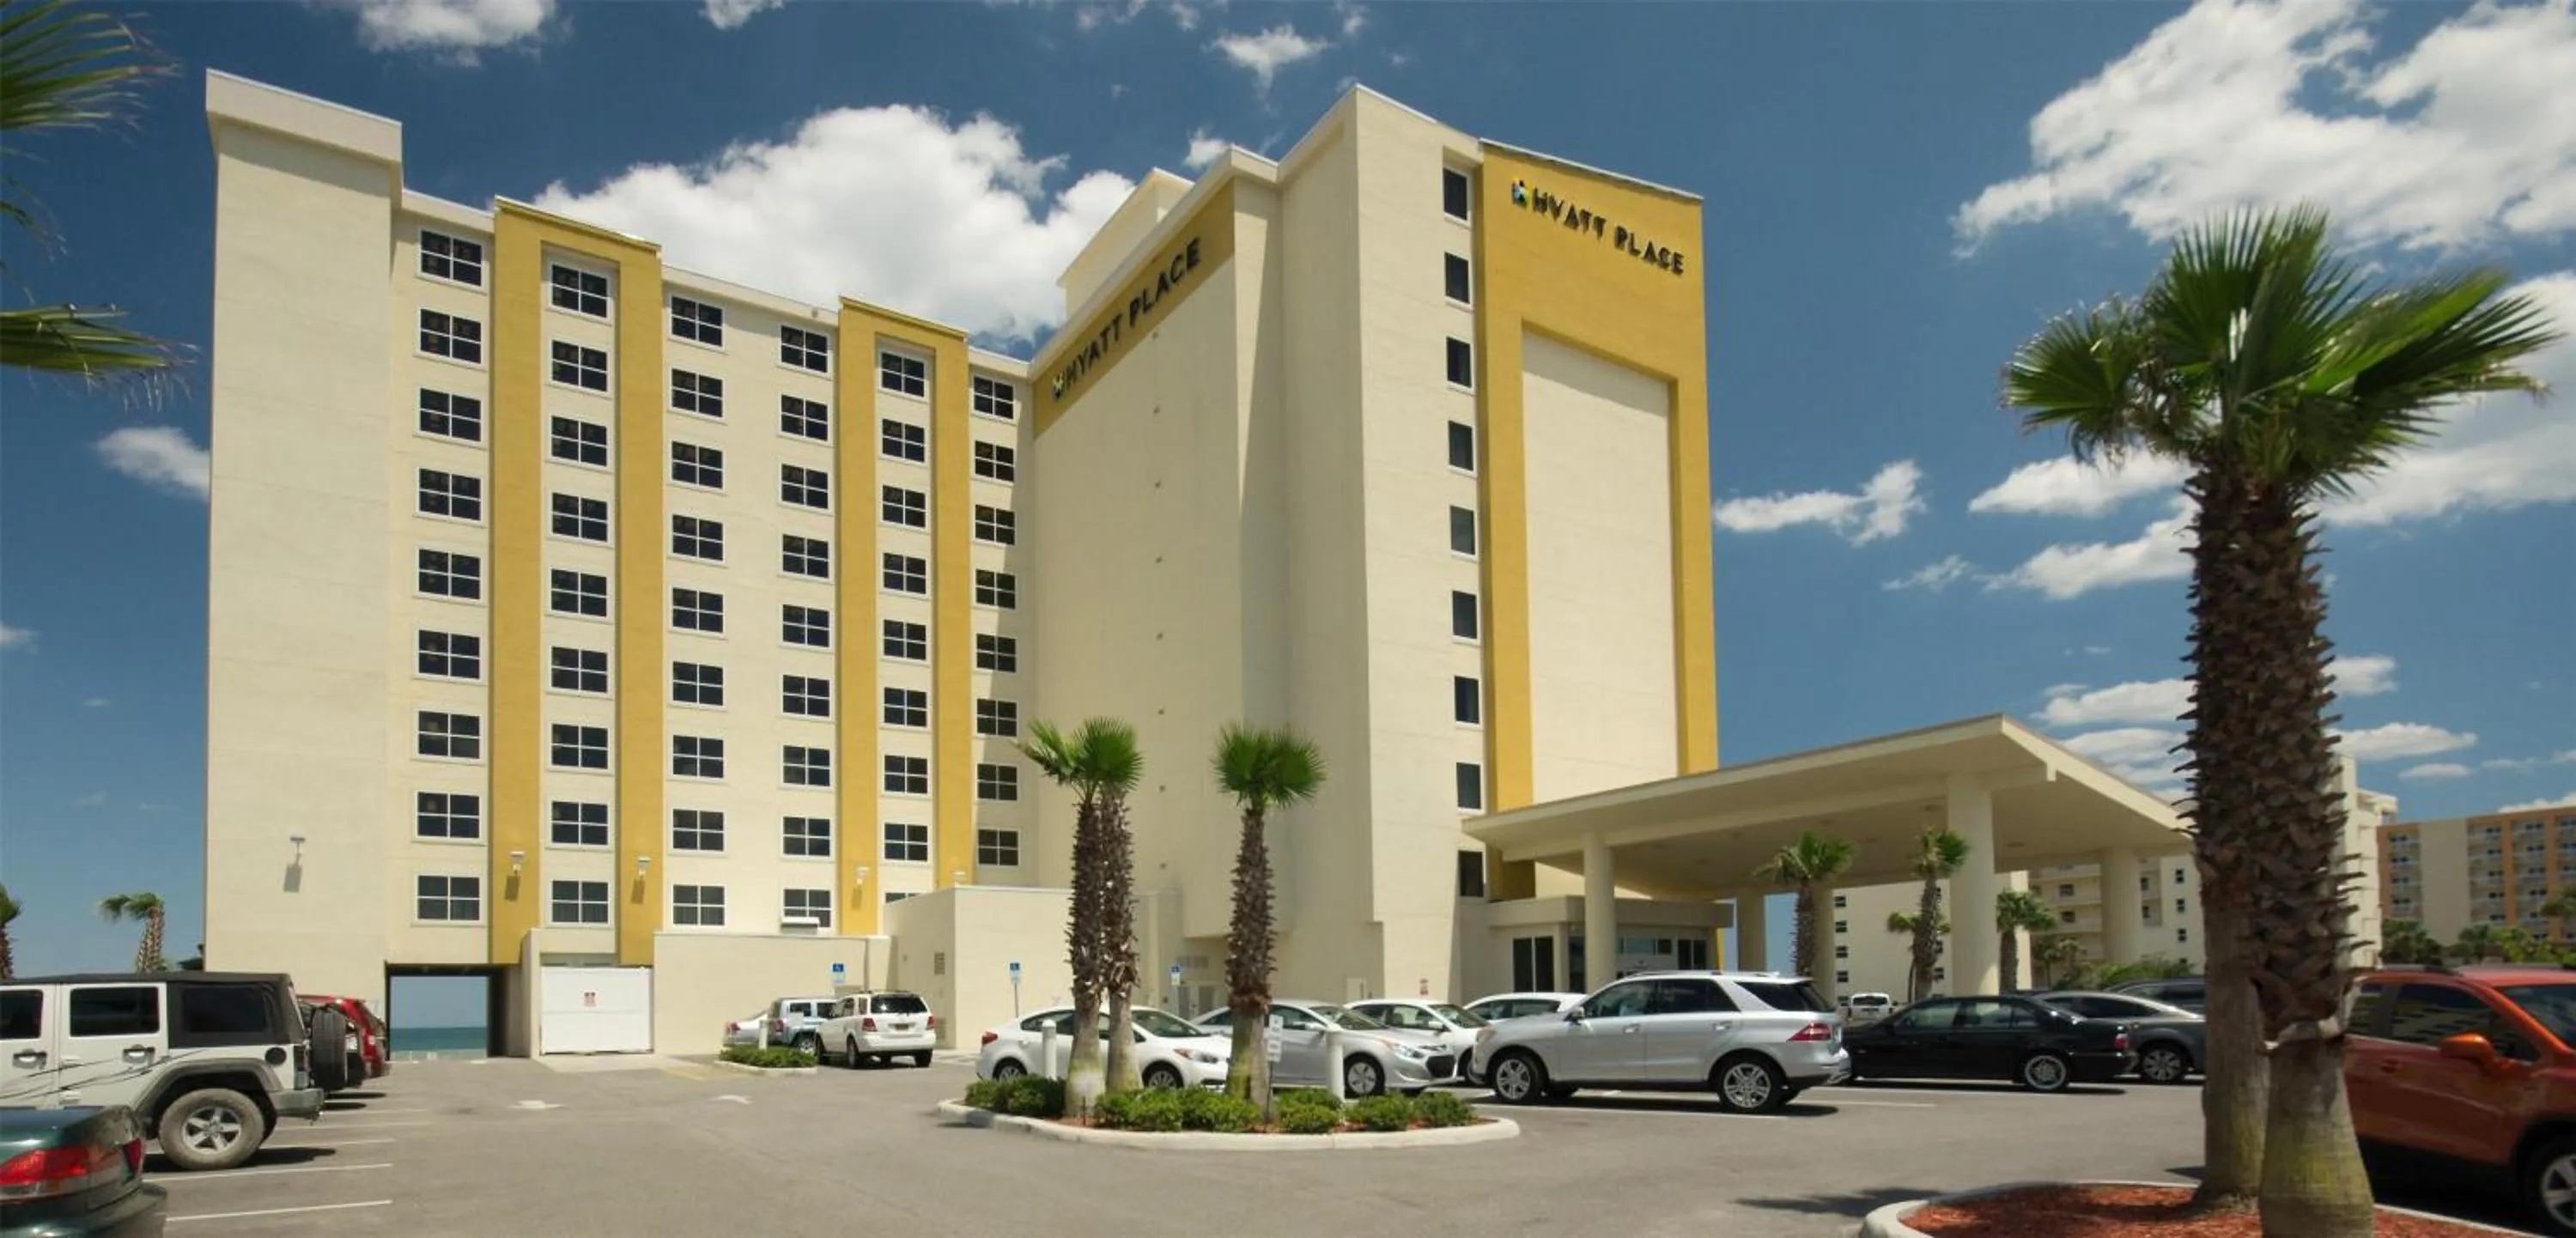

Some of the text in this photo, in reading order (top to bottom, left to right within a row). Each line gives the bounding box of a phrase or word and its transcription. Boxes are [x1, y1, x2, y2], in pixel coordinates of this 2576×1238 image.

[1532, 187, 1684, 276] HYATT PLACE
[1066, 237, 1200, 389] HYATT PLACE
